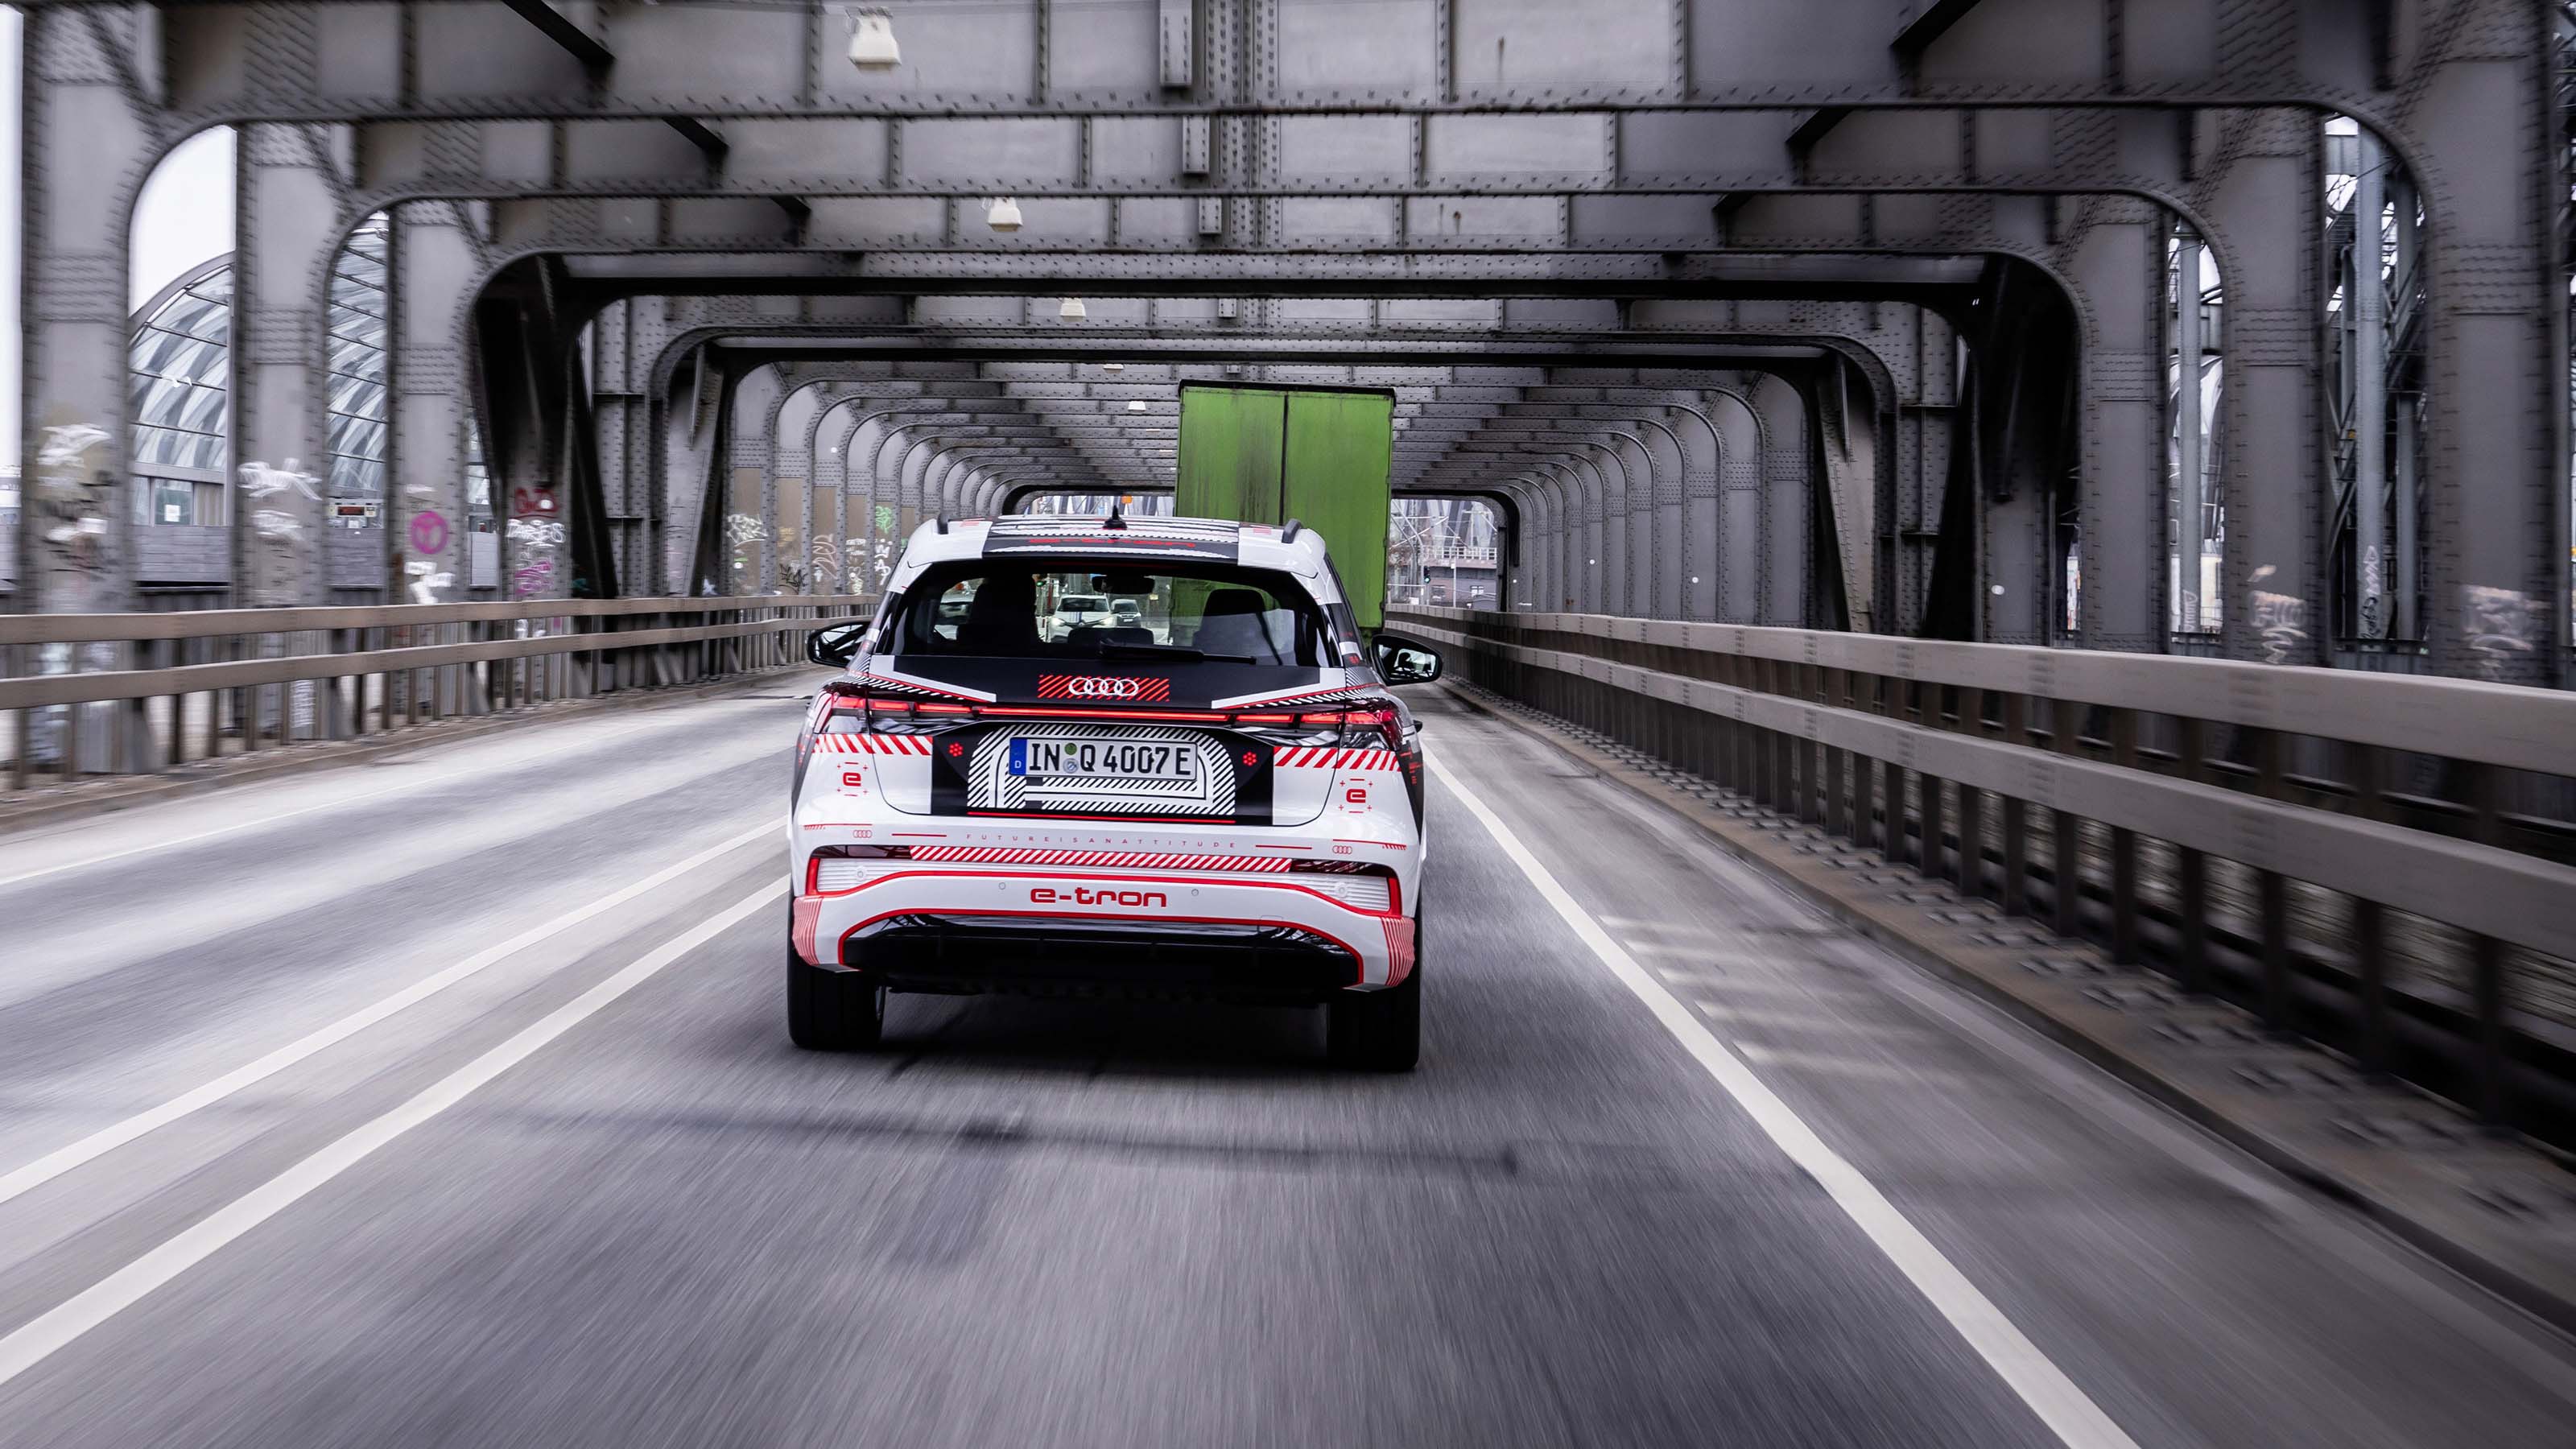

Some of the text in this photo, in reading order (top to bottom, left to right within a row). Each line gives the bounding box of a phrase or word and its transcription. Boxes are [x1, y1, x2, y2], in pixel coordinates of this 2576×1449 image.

[1014, 760, 1022, 769] D
[1029, 743, 1060, 771] IN
[1080, 744, 1096, 772] Q
[1030, 886, 1167, 908] e-tron
